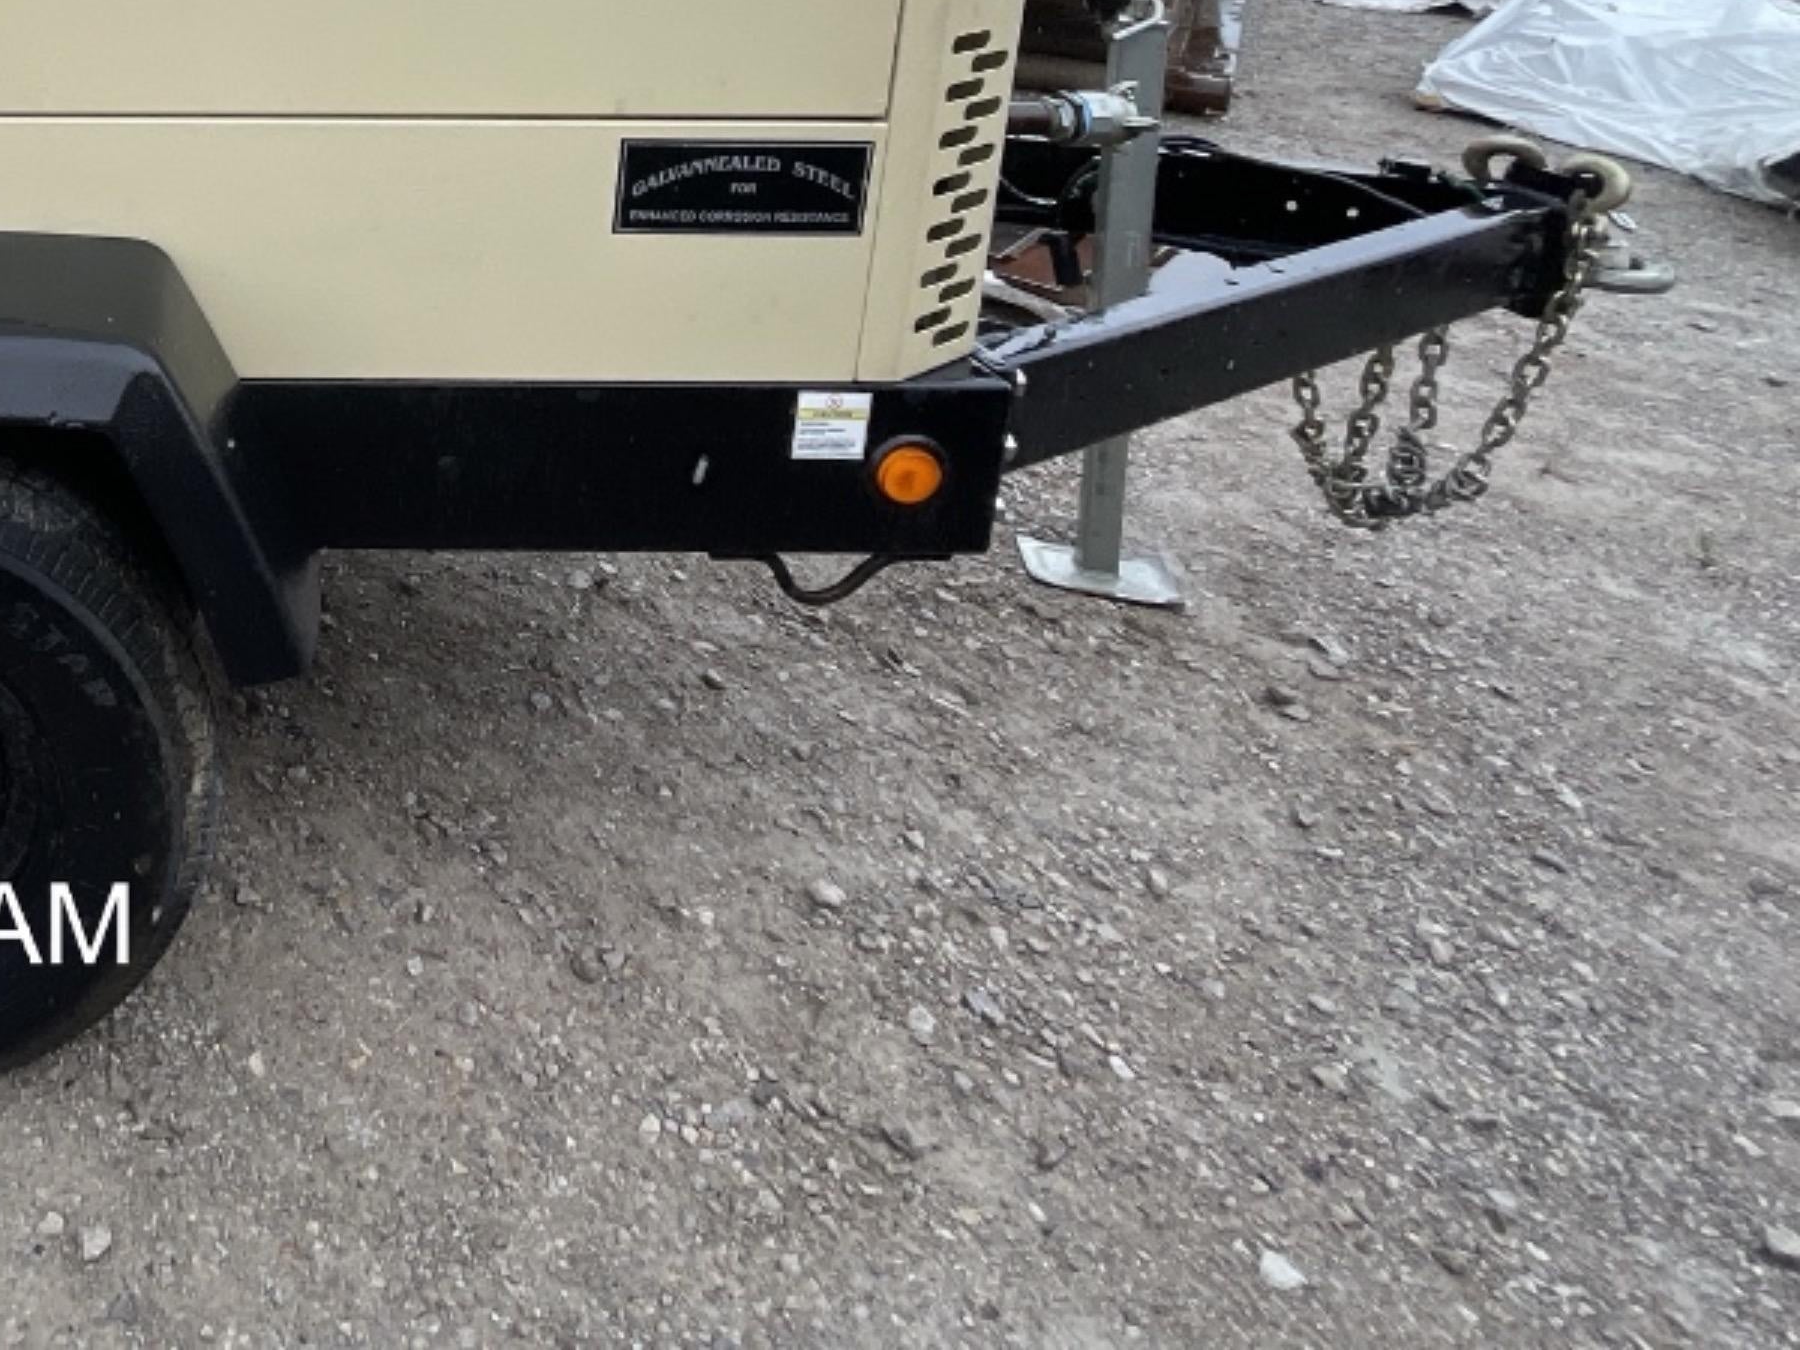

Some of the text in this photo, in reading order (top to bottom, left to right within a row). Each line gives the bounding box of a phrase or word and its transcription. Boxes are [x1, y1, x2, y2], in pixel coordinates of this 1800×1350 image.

[632, 155, 857, 200] GALVANNEALED STEEL
[730, 182, 758, 195] FOR
